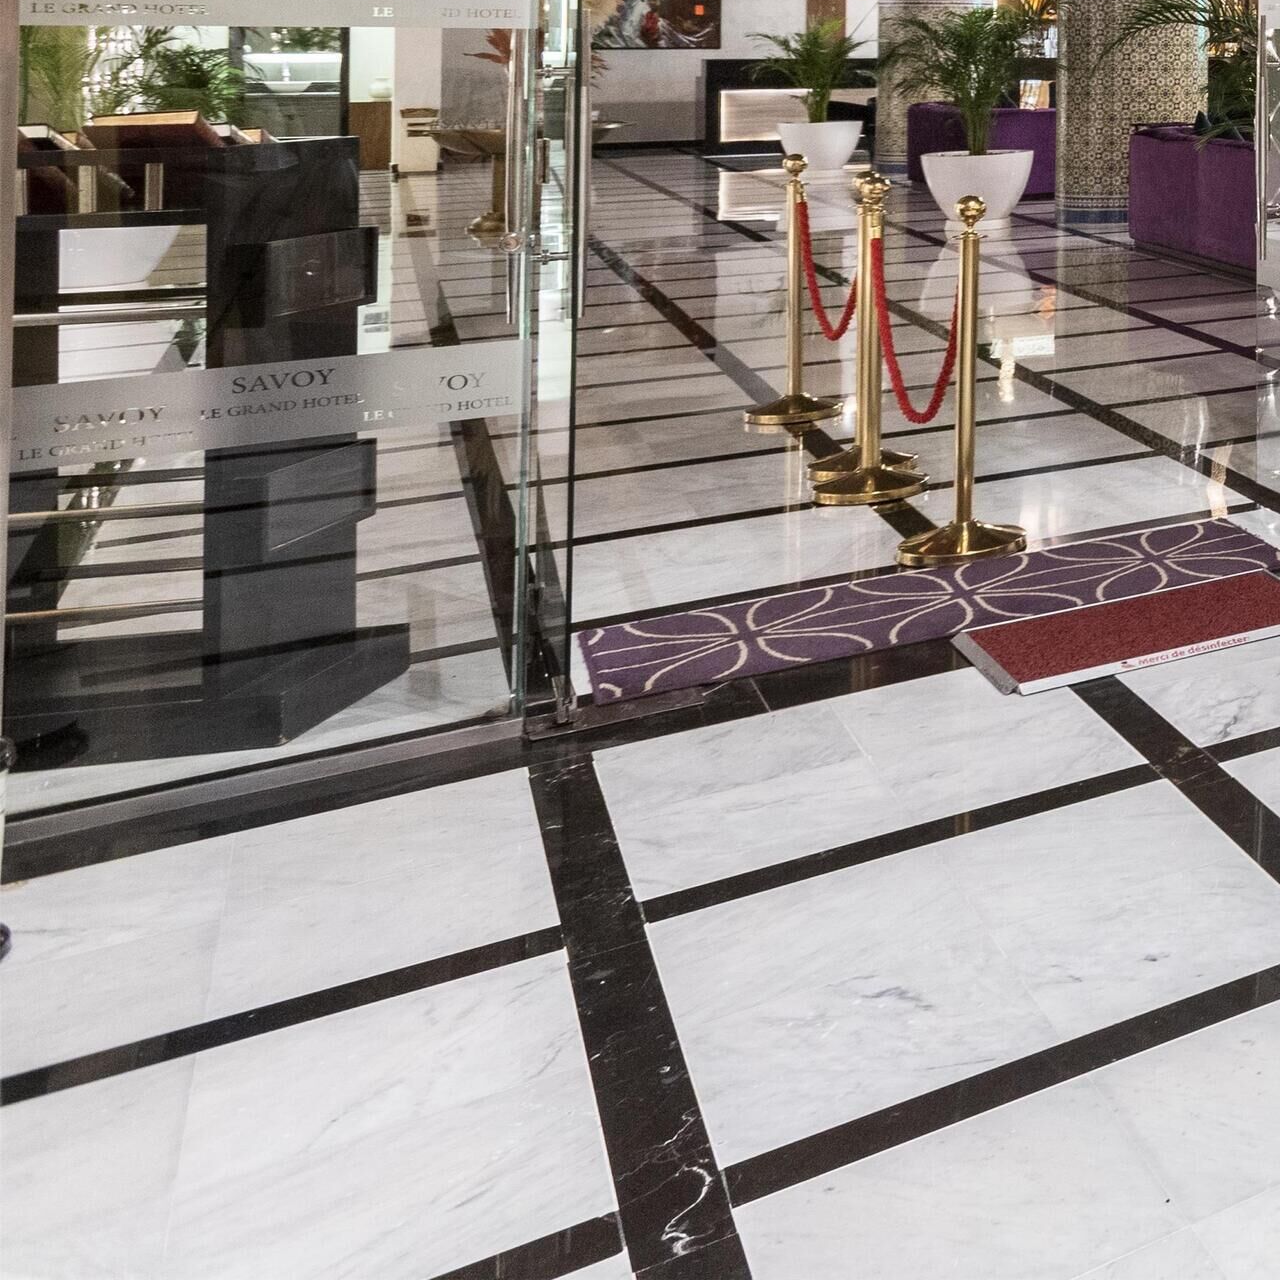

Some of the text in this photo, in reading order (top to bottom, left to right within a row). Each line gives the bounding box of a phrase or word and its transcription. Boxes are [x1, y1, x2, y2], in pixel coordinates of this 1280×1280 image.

[31, 2, 56, 15] LE
[372, 6, 395, 18] LE
[231, 368, 337, 394] SAVOY
[200, 392, 365, 420] LE GRAND HOTEL
[363, 409, 386, 422] LE
[456, 396, 515, 411] HOTEL
[53, 404, 167, 433] SAVOY
[18, 448, 43, 461] LE
[1171, 650, 1186, 658] de
